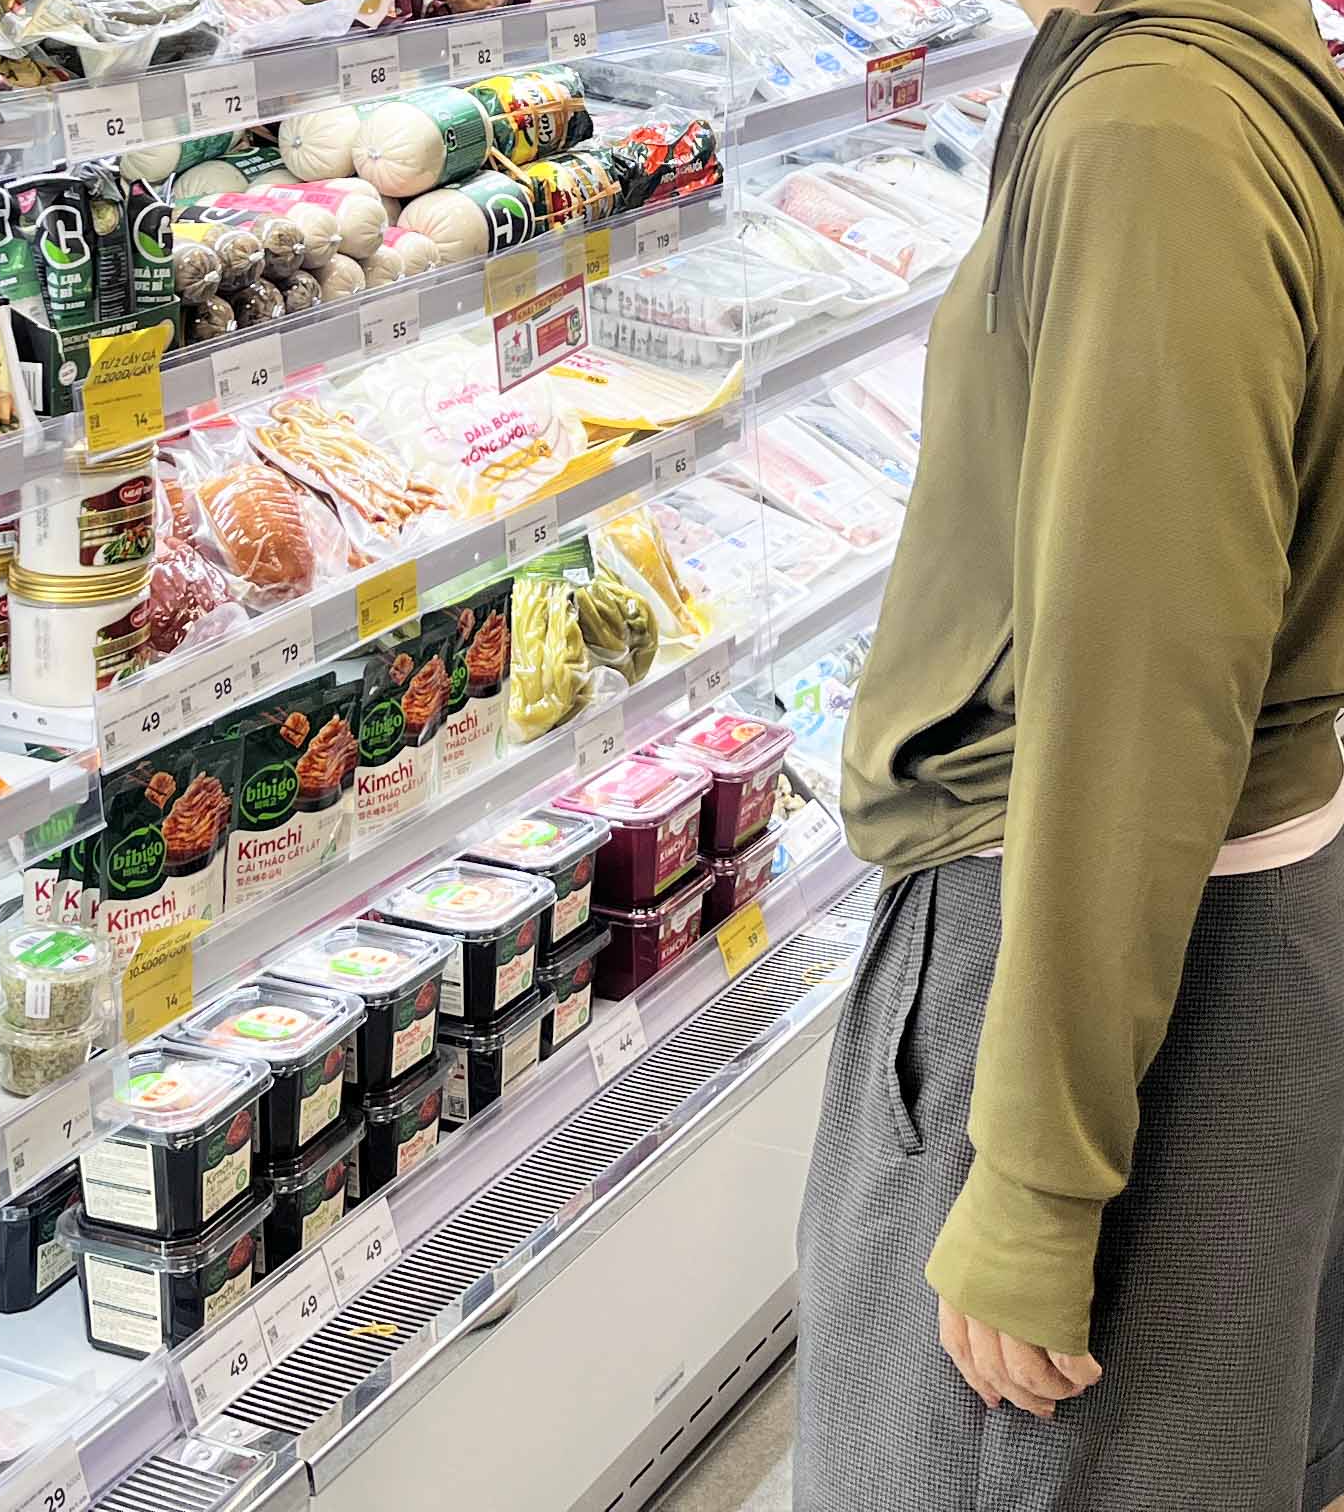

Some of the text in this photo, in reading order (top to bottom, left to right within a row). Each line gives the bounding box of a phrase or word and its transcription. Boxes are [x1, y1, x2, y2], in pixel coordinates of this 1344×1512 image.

[688, 11, 701, 25] 43
[573, 32, 587, 48] 98
[478, 48, 492, 65] 82
[371, 67, 387, 85] 68
[225, 95, 243, 113] 72
[106, 117, 126, 137] 62
[657, 233, 670, 249] 119
[587, 261, 601, 274] 109
[393, 320, 407, 338] 55
[251, 368, 268, 385] 49
[134, 412, 148, 426] 14
[676, 458, 687, 473] 65
[535, 526, 547, 542] 55
[392, 598, 406, 614] 57
[283, 644, 299, 663] 79
[706, 671, 722, 688] 155
[215, 679, 232, 699] 98
[142, 712, 161, 733] 49
[360, 713, 403, 741] bibigo
[602, 736, 614, 754] 29
[246, 774, 298, 803] bibigo
[357, 763, 414, 796] Kimchi
[238, 823, 303, 861] Kimchi
[112, 841, 164, 869] bibigo
[236, 857, 254, 875] CẢI
[257, 850, 286, 872] THẢO
[107, 892, 177, 933] Kimchi
[165, 993, 179, 1008] 14
[619, 1034, 634, 1052] 44
[61, 1119, 72, 1139] 7
[367, 1239, 383, 1261] 49
[301, 1294, 317, 1319] 49
[230, 1352, 248, 1377] 49
[45, 1487, 76, 1512] 29
